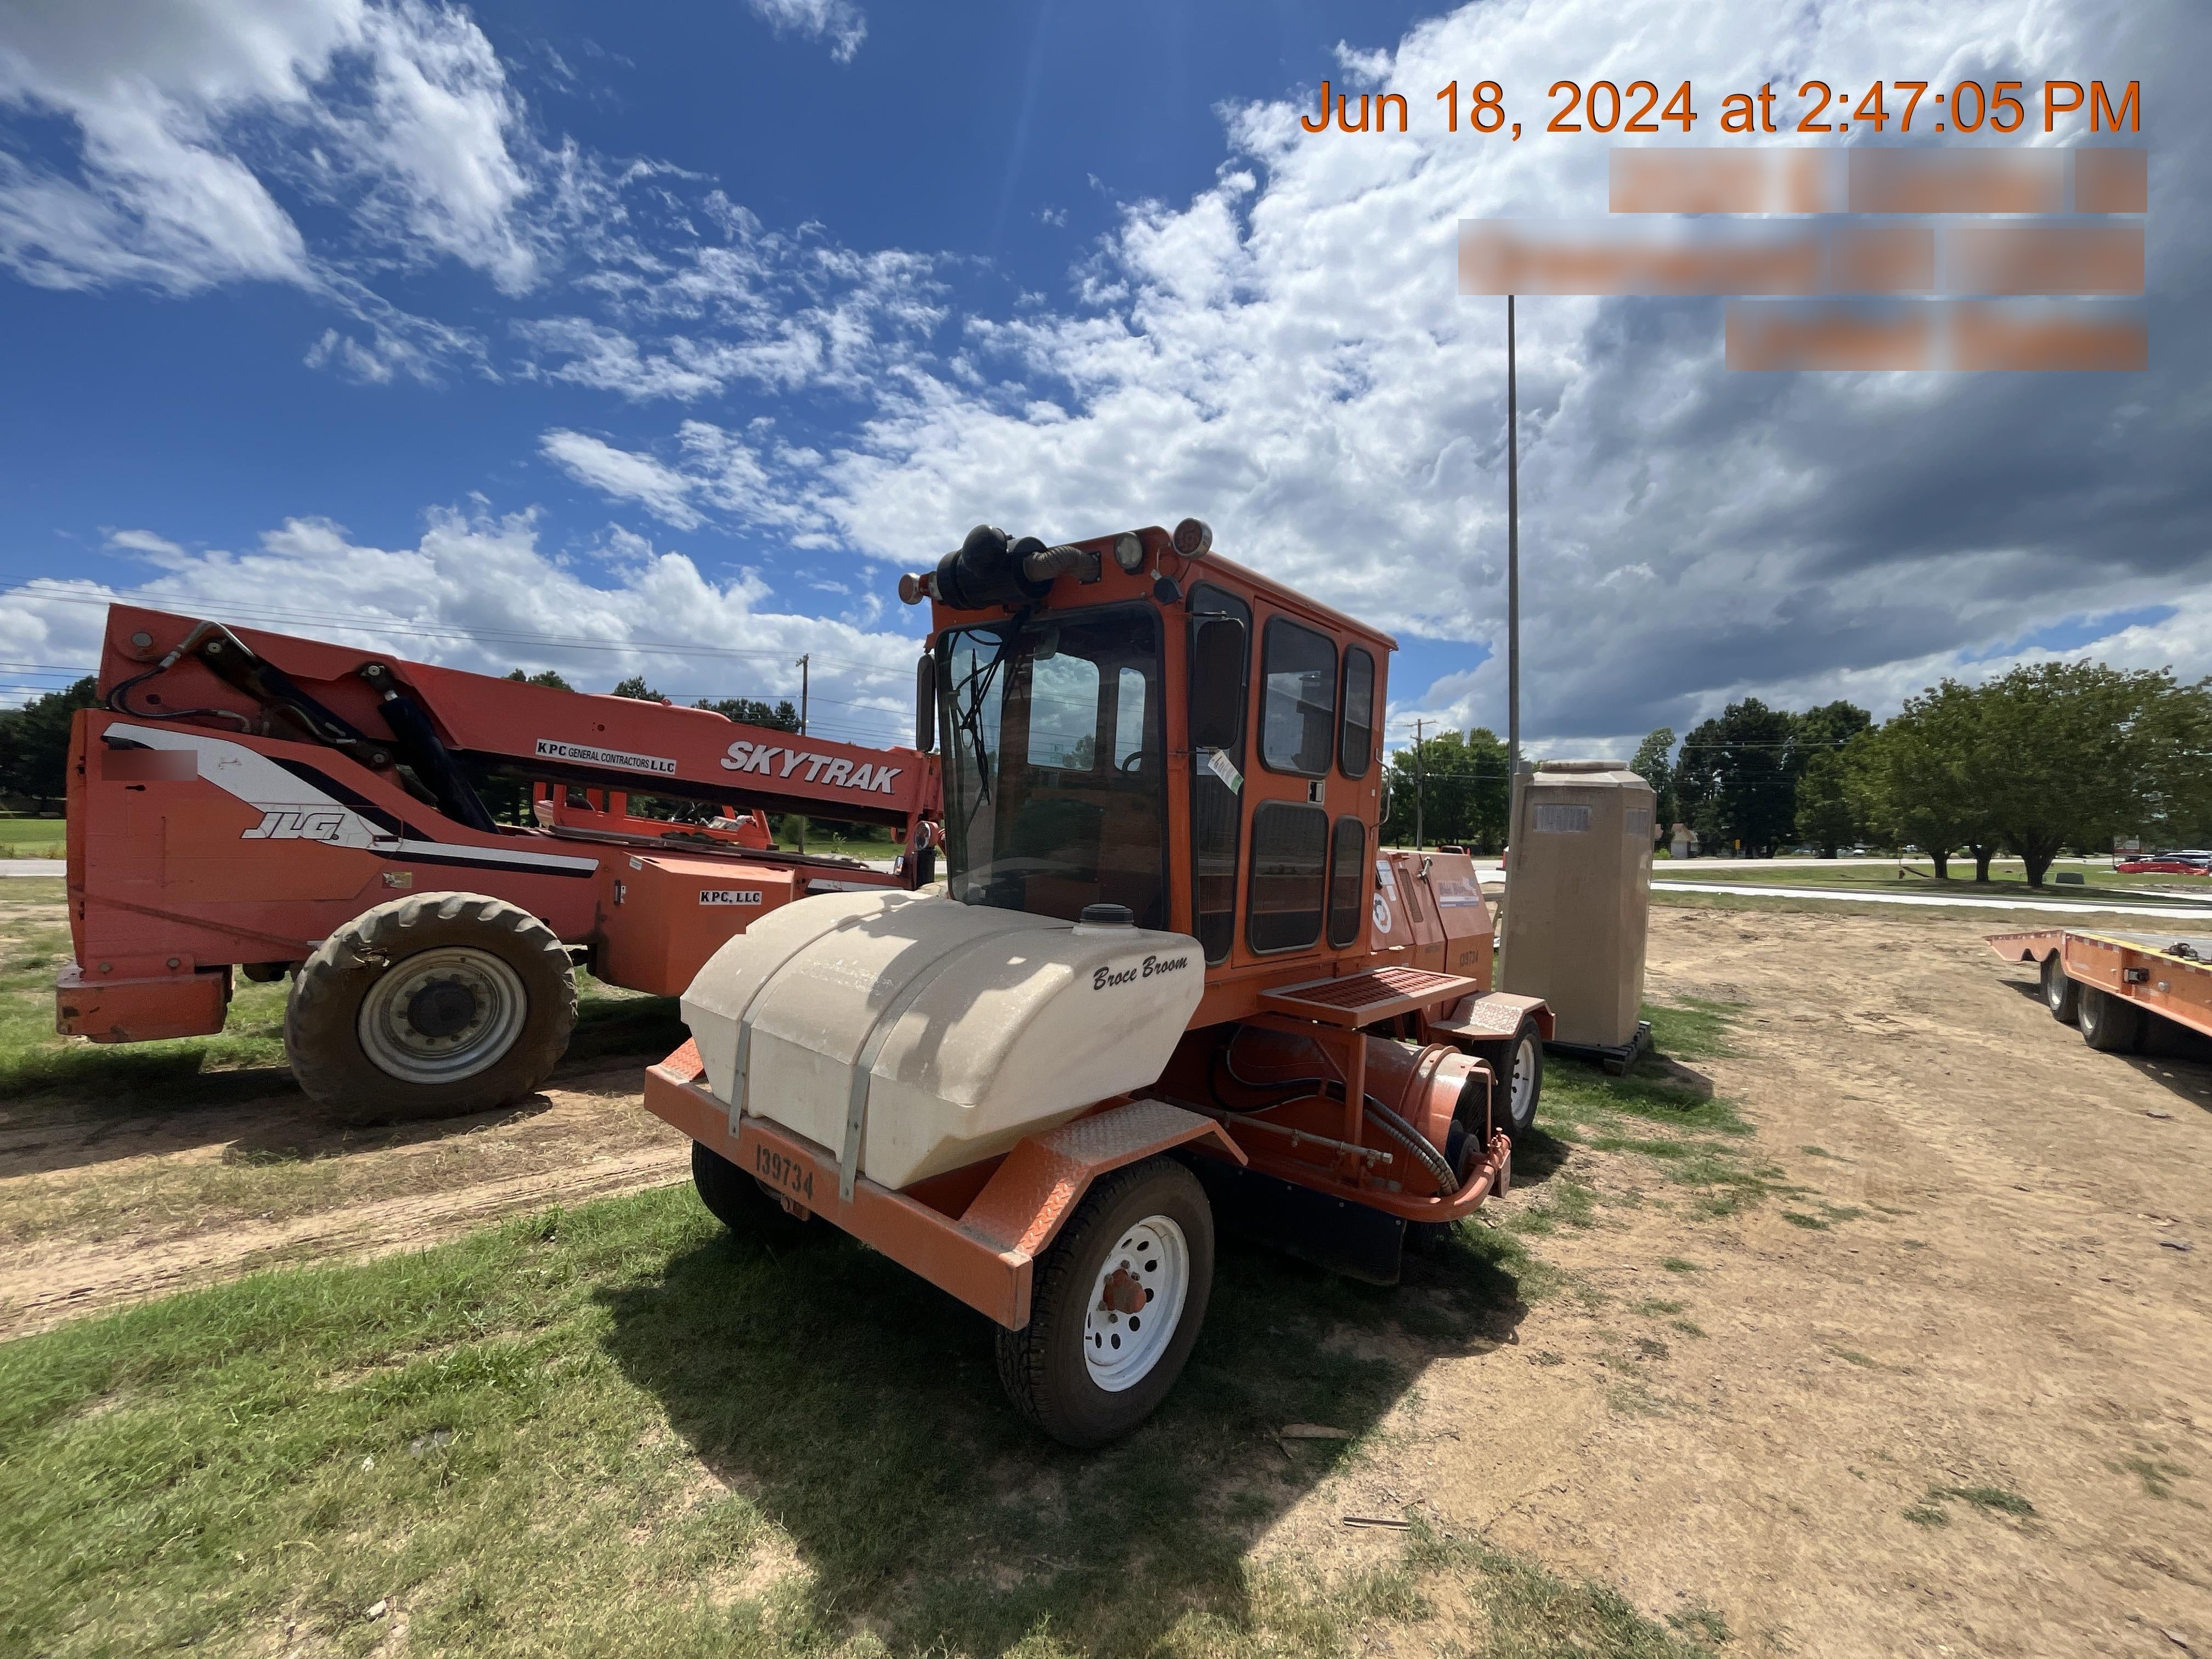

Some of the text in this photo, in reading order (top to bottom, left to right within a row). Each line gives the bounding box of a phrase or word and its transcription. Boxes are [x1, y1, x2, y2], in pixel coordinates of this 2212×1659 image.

[538, 742, 675, 772] KPC GENERAL CONTRACTORS LLC
[720, 741, 902, 793] SKYTRAK
[240, 812, 345, 840] JLG
[701, 891, 759, 904] KPC, LLC
[1093, 955, 1188, 990] Broce Broom
[757, 1144, 813, 1200] 139734
